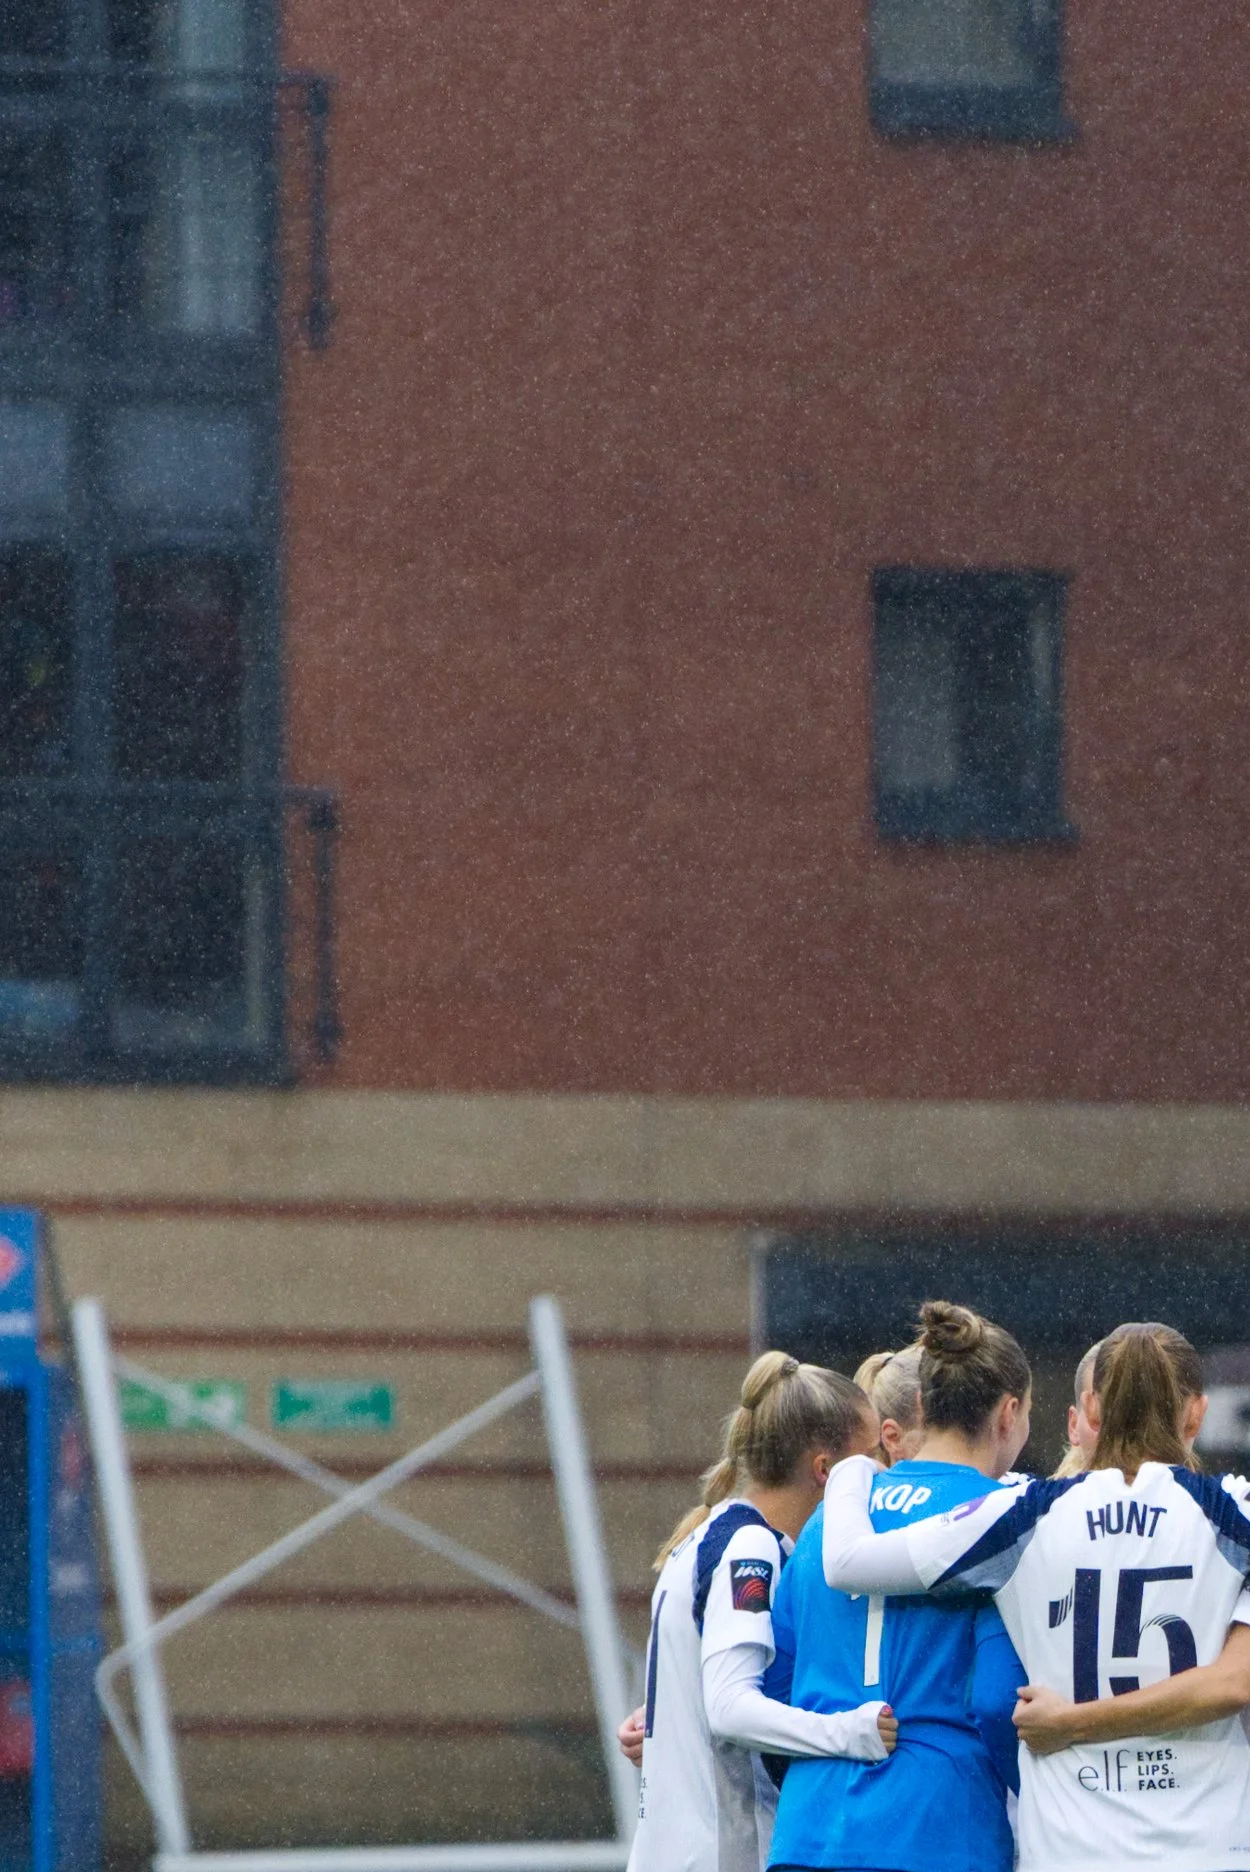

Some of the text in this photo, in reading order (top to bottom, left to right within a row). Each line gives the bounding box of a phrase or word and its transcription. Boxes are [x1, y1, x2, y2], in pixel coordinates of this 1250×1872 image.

[870, 1484, 932, 1514] KOP
[1086, 1501, 1168, 1541] HUNT
[1049, 1565, 1198, 1704] 15
[1137, 1748, 1178, 1762] EYES.
[1138, 1763, 1174, 1776] LIPS.
[1138, 1778, 1180, 1791] FACE.
